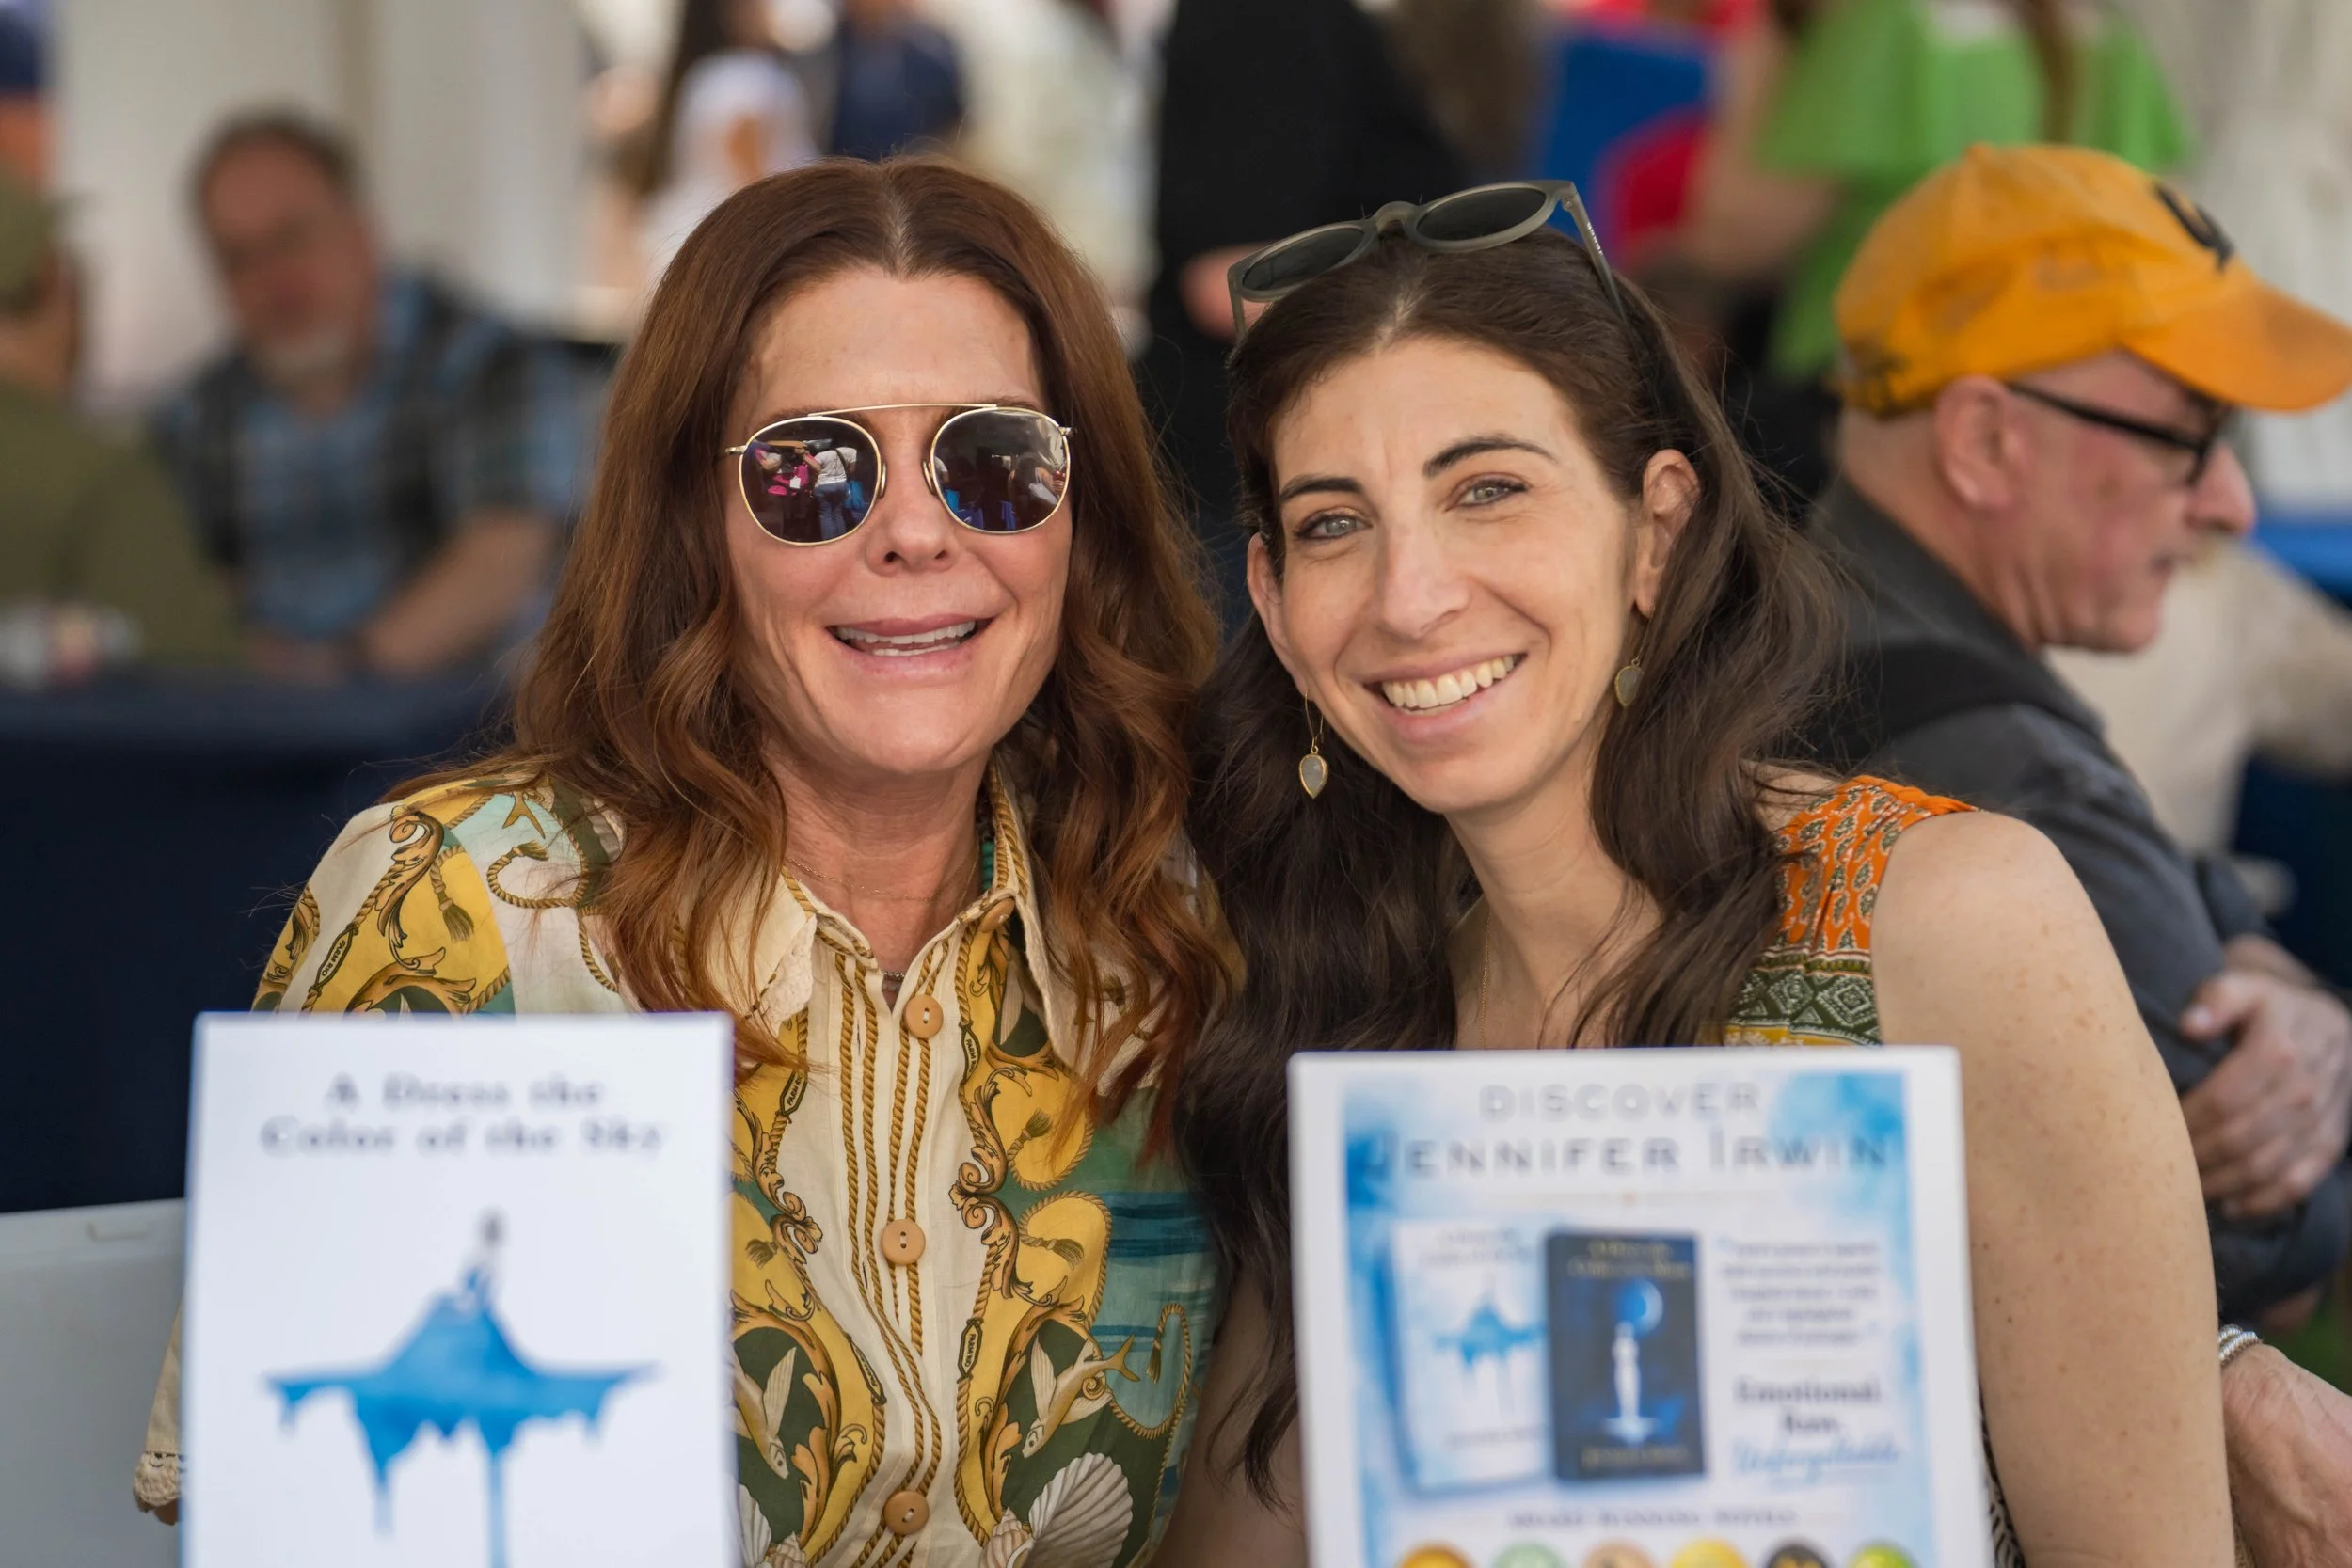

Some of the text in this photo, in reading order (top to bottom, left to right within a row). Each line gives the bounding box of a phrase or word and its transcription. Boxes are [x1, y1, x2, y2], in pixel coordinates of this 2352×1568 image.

[321, 940, 346, 976] FARM RIO
[965, 1038, 977, 1059] FARM
[326, 1073, 360, 1112] A
[528, 1072, 604, 1112] the
[786, 1085, 800, 1106] FARM
[1478, 1081, 1763, 1123] DISCOVER
[259, 1115, 395, 1157] Color
[417, 1115, 472, 1157] of
[485, 1116, 563, 1157] the
